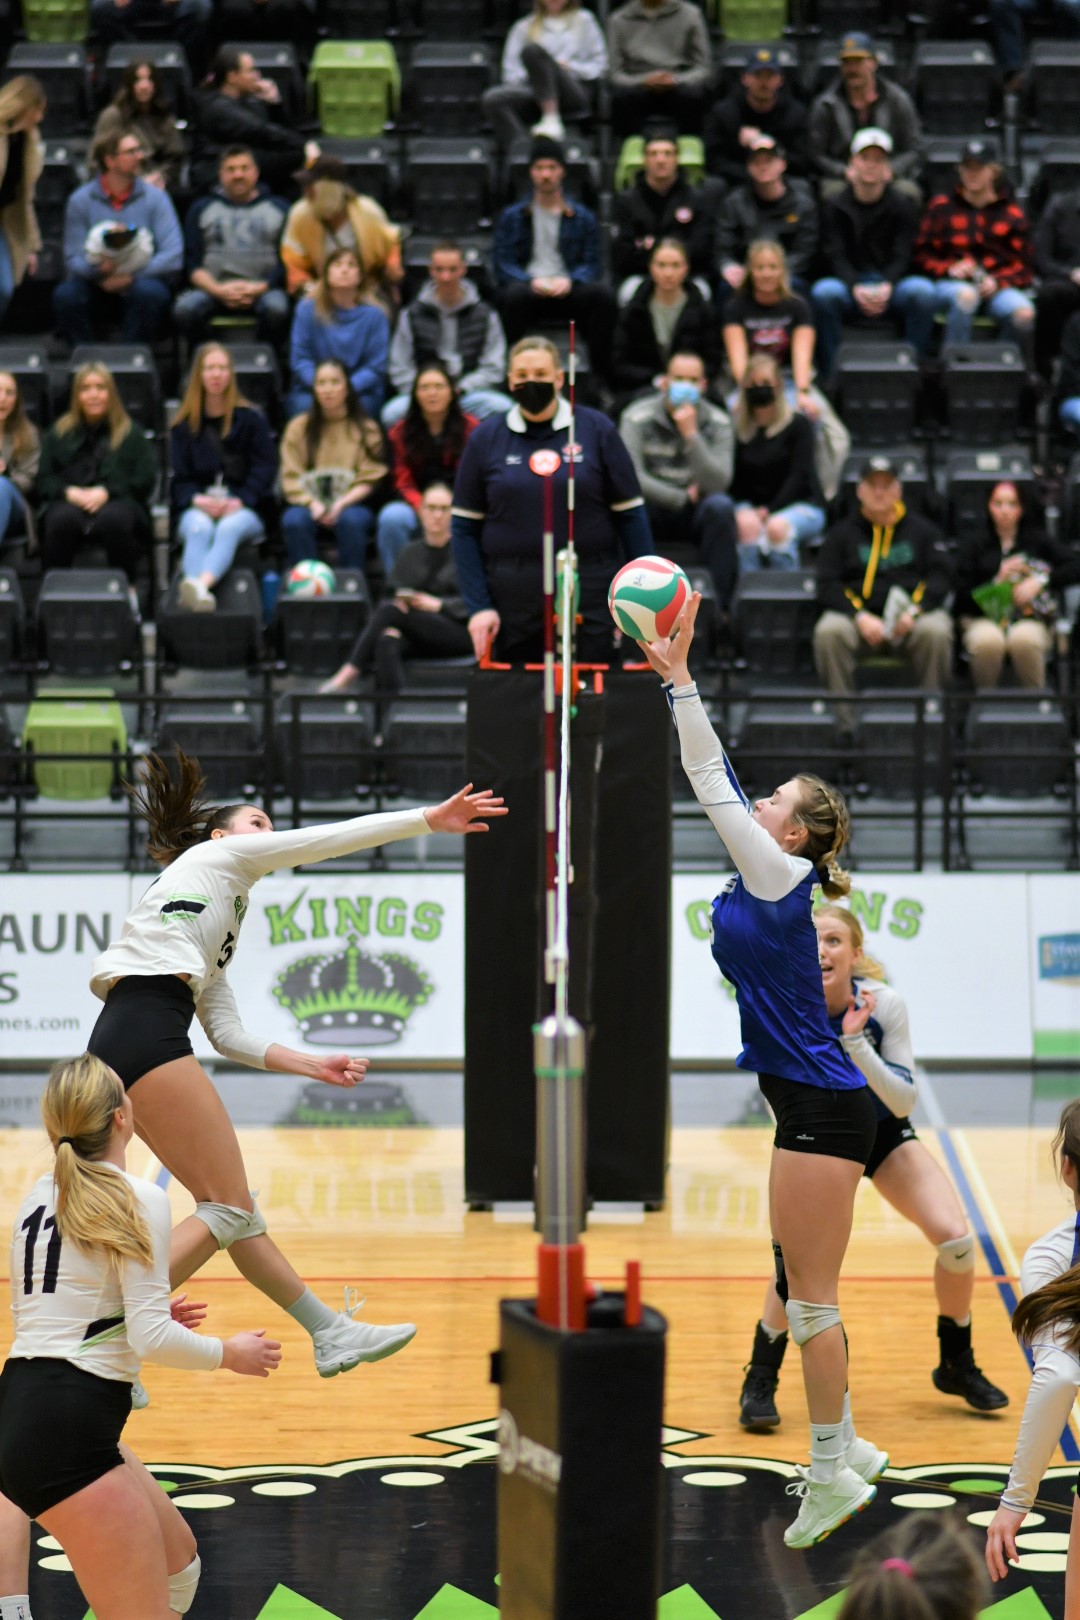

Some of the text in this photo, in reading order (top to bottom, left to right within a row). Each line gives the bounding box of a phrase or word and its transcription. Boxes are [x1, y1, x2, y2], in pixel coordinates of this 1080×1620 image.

[0, 912, 111, 955] AUN
[263, 886, 445, 946] KINGS
[21, 1204, 62, 1296] 11
